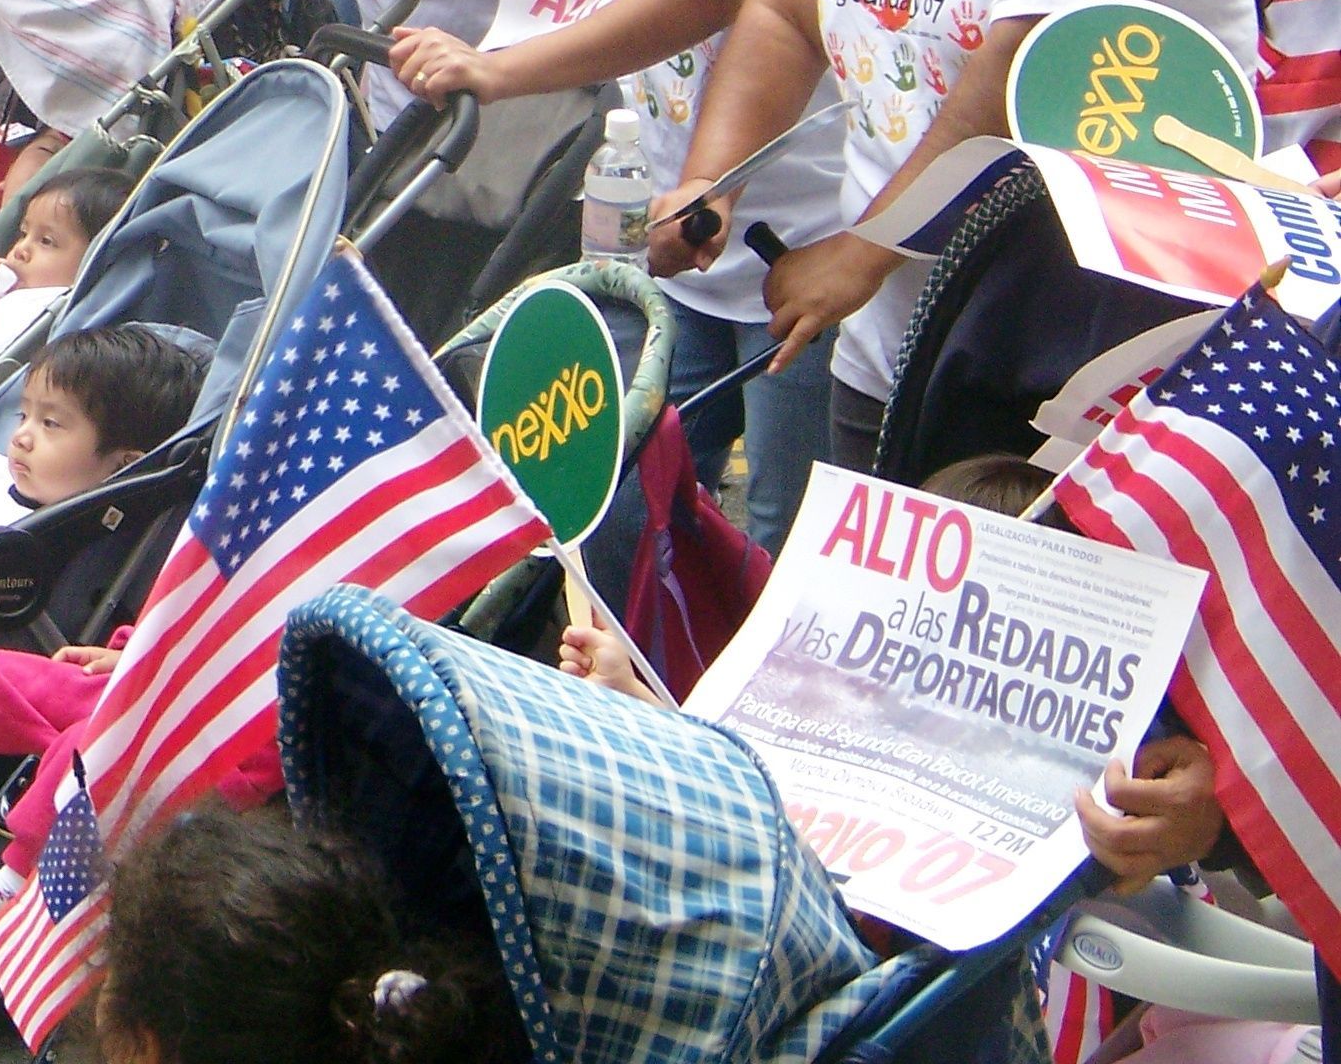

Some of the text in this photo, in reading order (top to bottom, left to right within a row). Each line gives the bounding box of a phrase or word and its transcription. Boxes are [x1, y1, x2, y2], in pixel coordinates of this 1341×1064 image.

[1072, 24, 1162, 156] exxo
[491, 362, 605, 465] nexxo
[820, 483, 973, 593] ALTO
[1041, 539, 1066, 555] PARA
[771, 617, 803, 653] y
[796, 611, 840, 661] las
[834, 610, 1125, 755] DEPORTACIONES
[888, 598, 908, 632] a
[909, 590, 948, 644] las
[948, 579, 1142, 702] REDADAS
[734, 692, 801, 730] Participa
[796, 717, 816, 734] en
[815, 720, 840, 738] el
[834, 723, 898, 755] Segundo
[892, 742, 934, 768] Gran
[927, 756, 984, 790] Boicot
[977, 776, 1068, 822] Americano
[782, 800, 907, 873] mayo
[899, 830, 1018, 906] '07
[968, 819, 1036, 856] 12 PM
